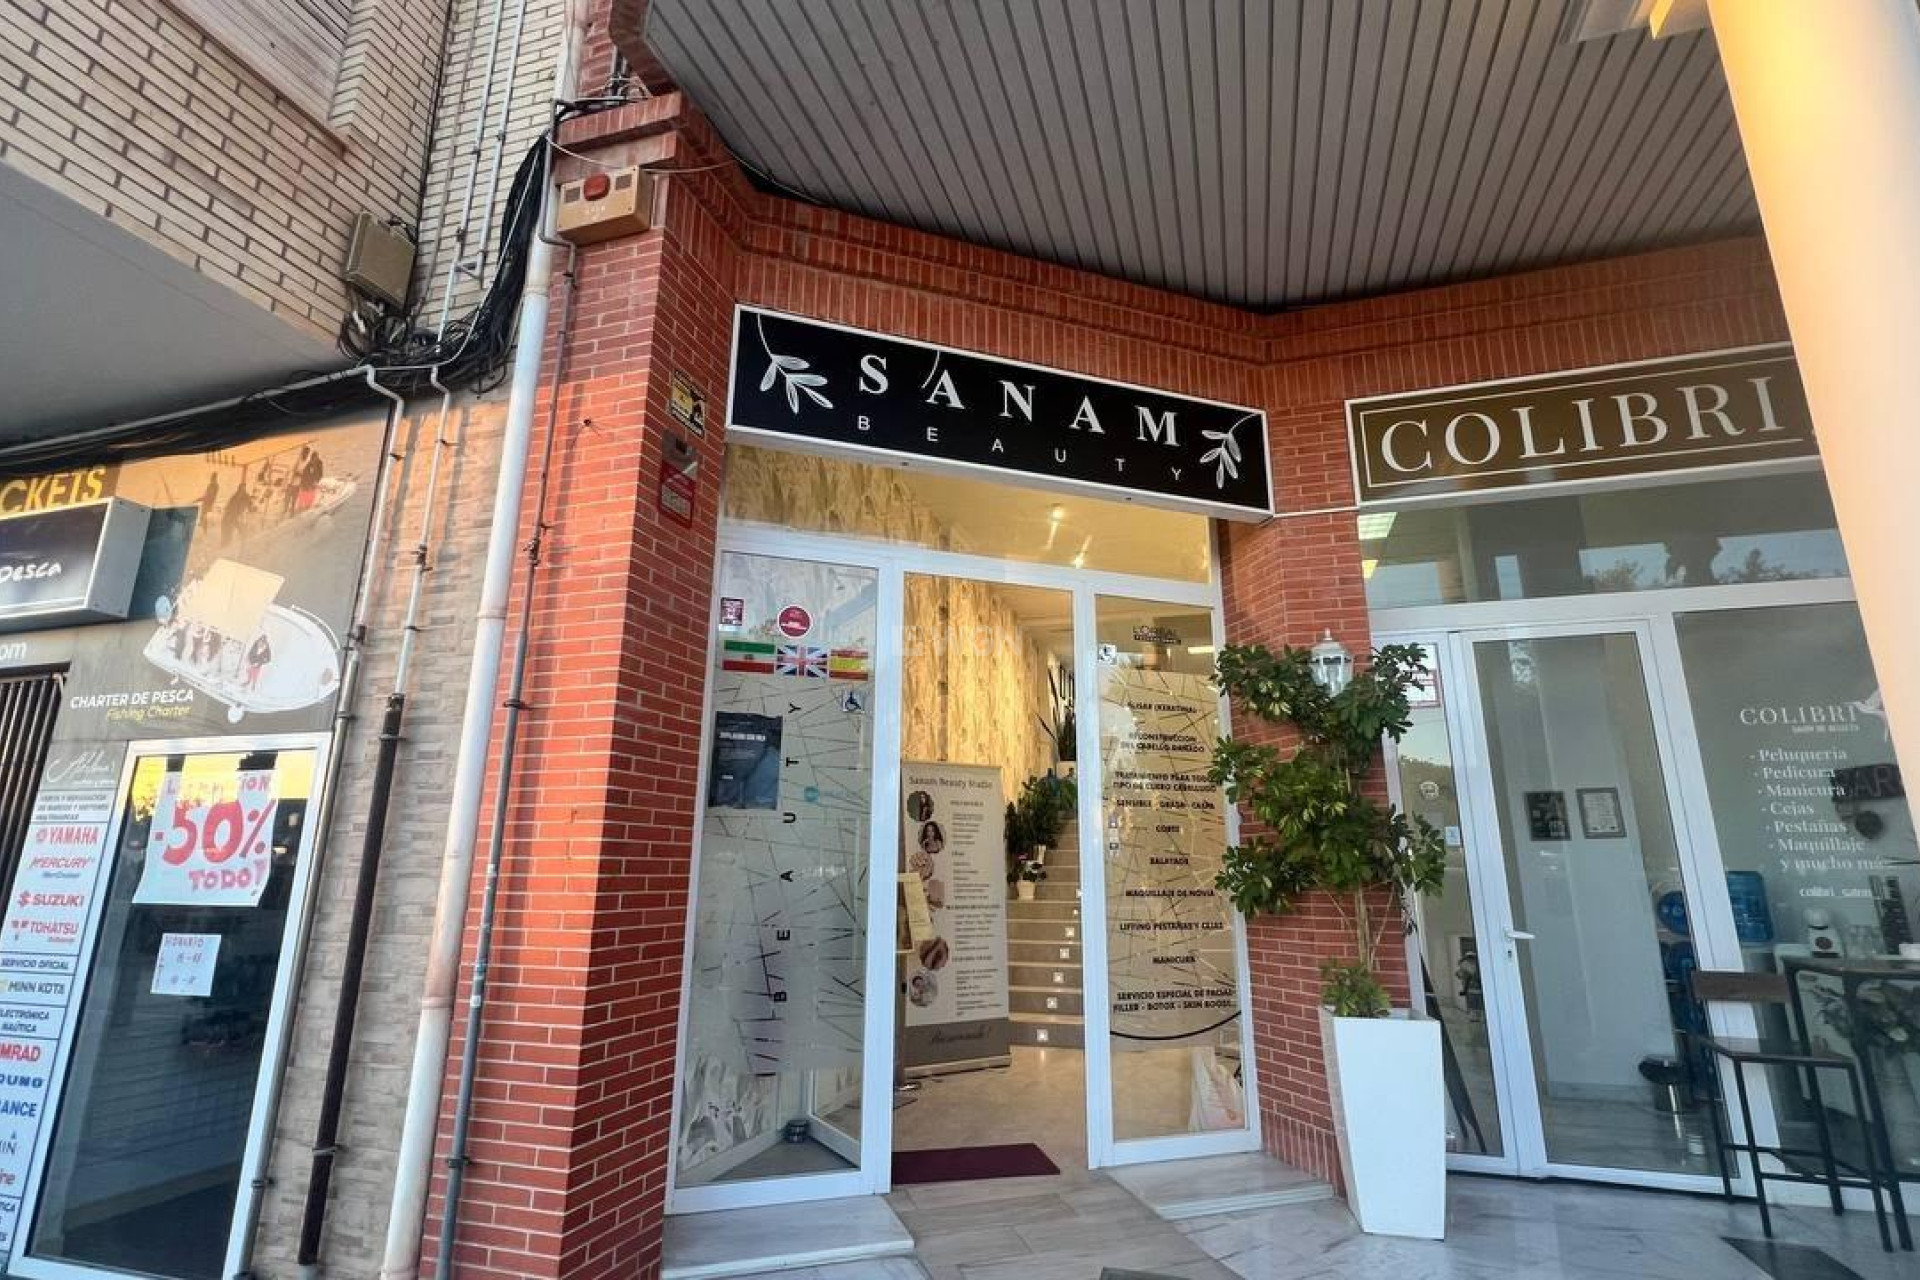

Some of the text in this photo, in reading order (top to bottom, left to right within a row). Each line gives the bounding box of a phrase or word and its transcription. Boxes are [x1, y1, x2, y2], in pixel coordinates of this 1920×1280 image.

[859, 355, 1181, 447] SANAM
[1380, 376, 1786, 473] COLIBRI
[858, 416, 1182, 481] BEAUTY
[70, 689, 194, 709] CHARTER DE PESCA
[147, 705, 192, 718] Charter
[1740, 704, 1859, 726] COLIBRI
[1170, 773, 1190, 782] PARA
[1763, 765, 1836, 780] Pedicura
[1113, 782, 1132, 790] TIPO
[1146, 782, 1171, 791] CUERO
[1173, 783, 1217, 793] CABELLUDO
[1766, 783, 1846, 797] Manicura
[1770, 802, 1815, 817] Cejas
[1774, 818, 1848, 834] Pestañas
[50, 827, 99, 845] YAMAHA
[773, 703, 802, 1003] BEAUTY
[1777, 836, 1866, 855] Maquillaje
[1795, 855, 1852, 870] mucho
[33, 893, 85, 906] SUZUKI
[1126, 889, 1215, 897] MAQUILLAJE DE NOVIA
[30, 921, 79, 934] TOHATSU
[1120, 923, 1151, 931] LIFTING
[38, 960, 69, 970] OFICIAL
[1117, 991, 1155, 1000] SERVICIO
[1157, 990, 1193, 999] ESPECIAL
[1113, 1003, 1139, 1013] FILLER
[1147, 1002, 1175, 1011] BOTOX
[1183, 1001, 1202, 1010] SKIN
